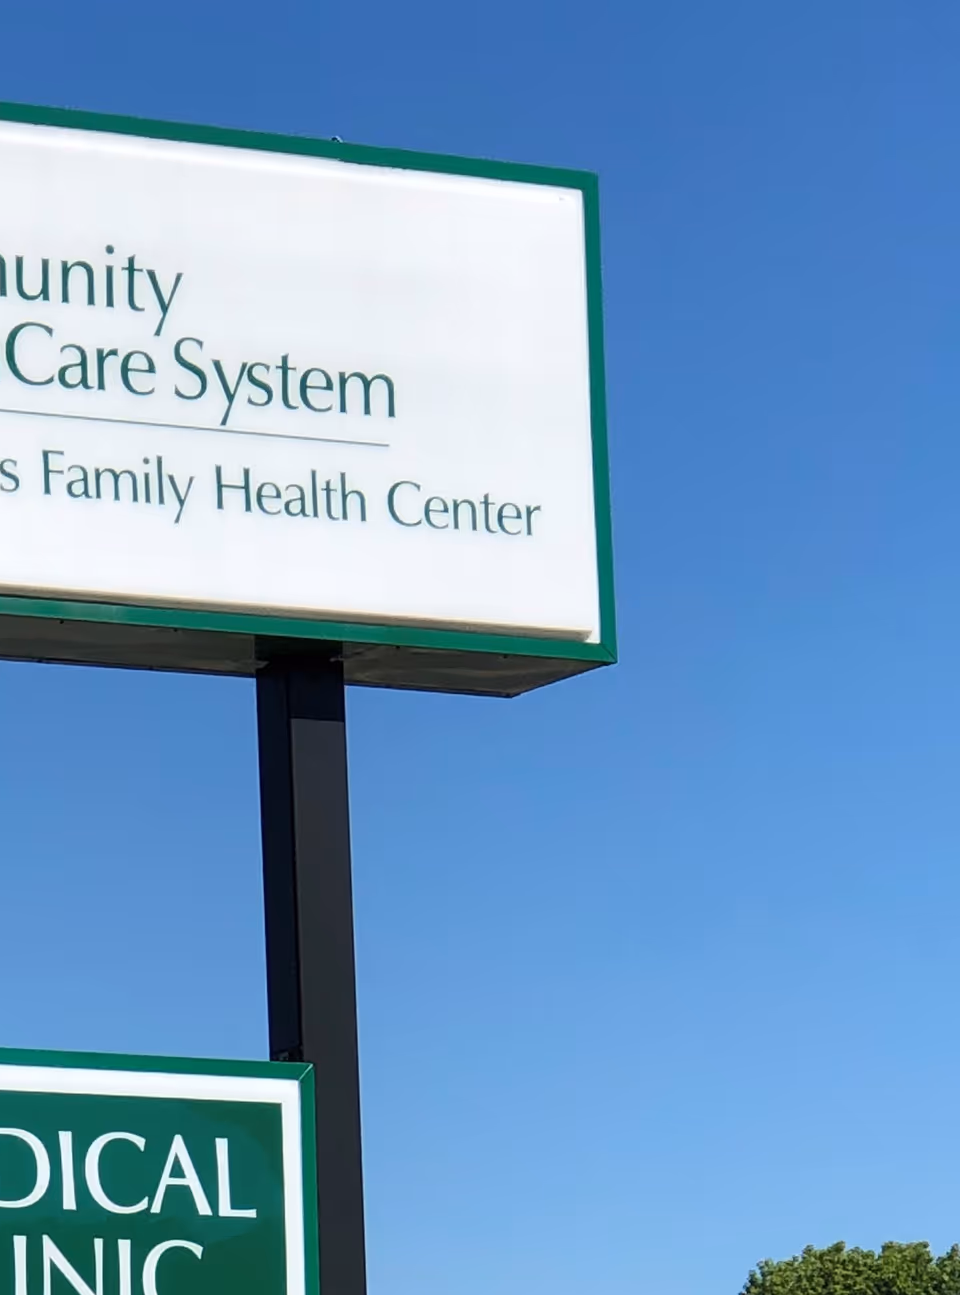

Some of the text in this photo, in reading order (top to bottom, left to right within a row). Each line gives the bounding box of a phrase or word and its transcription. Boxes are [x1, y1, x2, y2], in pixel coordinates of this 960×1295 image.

[173, 337, 396, 427] System
[41, 449, 194, 524] Family
[215, 465, 367, 522] Health
[387, 480, 541, 536] Center
